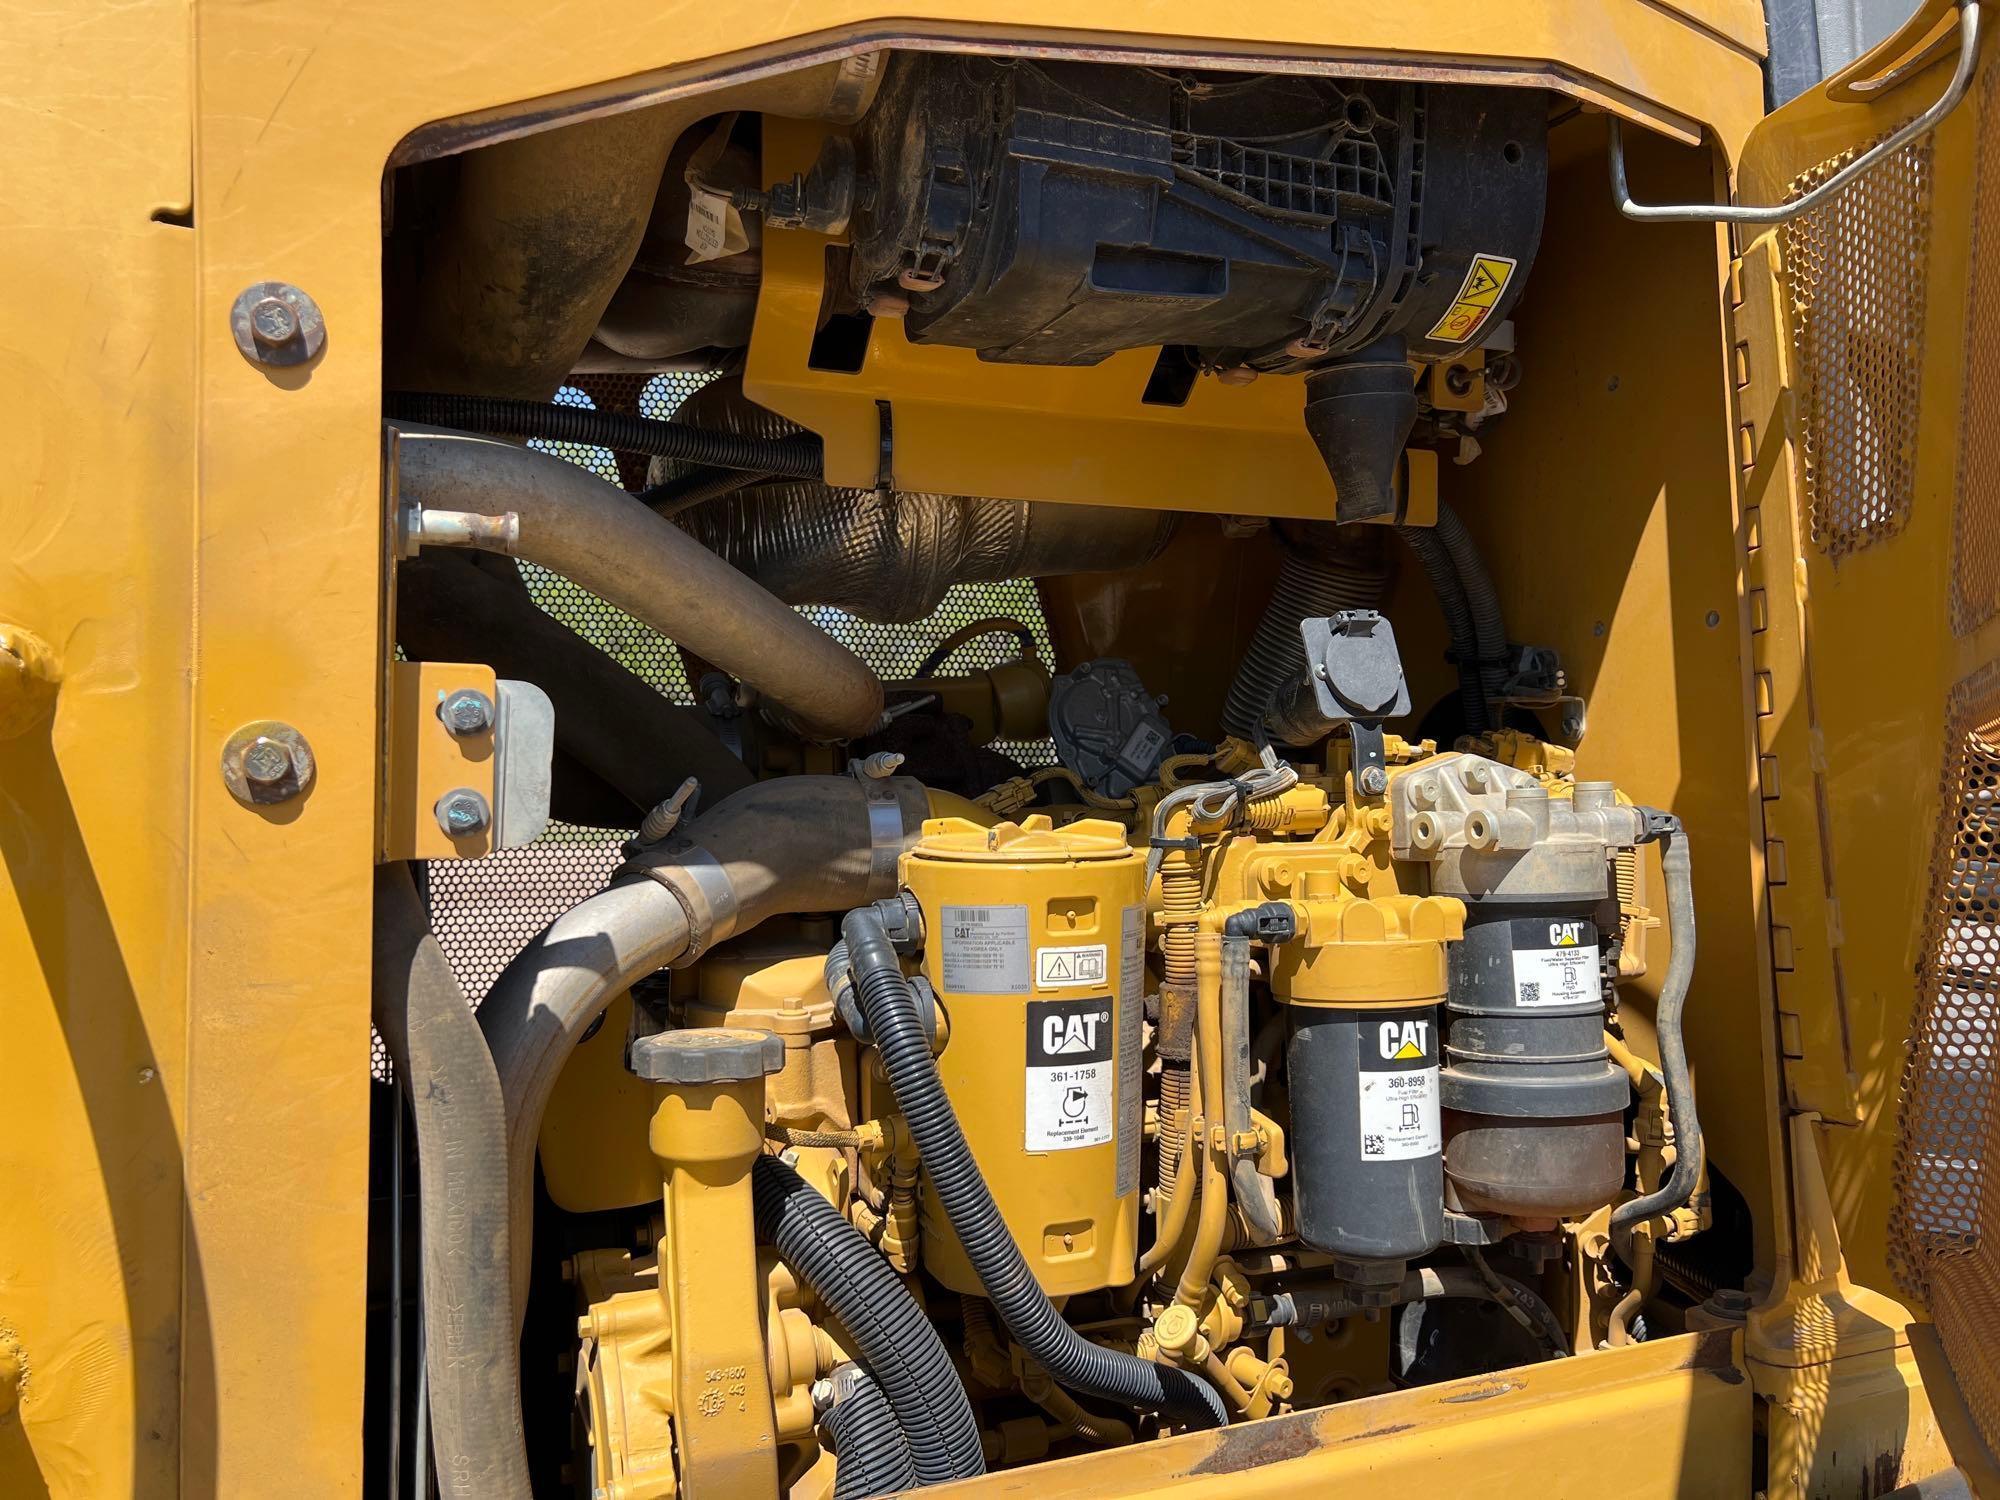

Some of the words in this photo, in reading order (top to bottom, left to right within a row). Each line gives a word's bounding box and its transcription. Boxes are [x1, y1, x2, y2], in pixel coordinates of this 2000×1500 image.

[1379, 1021, 1428, 1059] CAT
[1051, 1069, 1096, 1082] 361-1758
[1047, 1128, 1079, 1137] Replacement
[1081, 1126, 1098, 1134] Element
